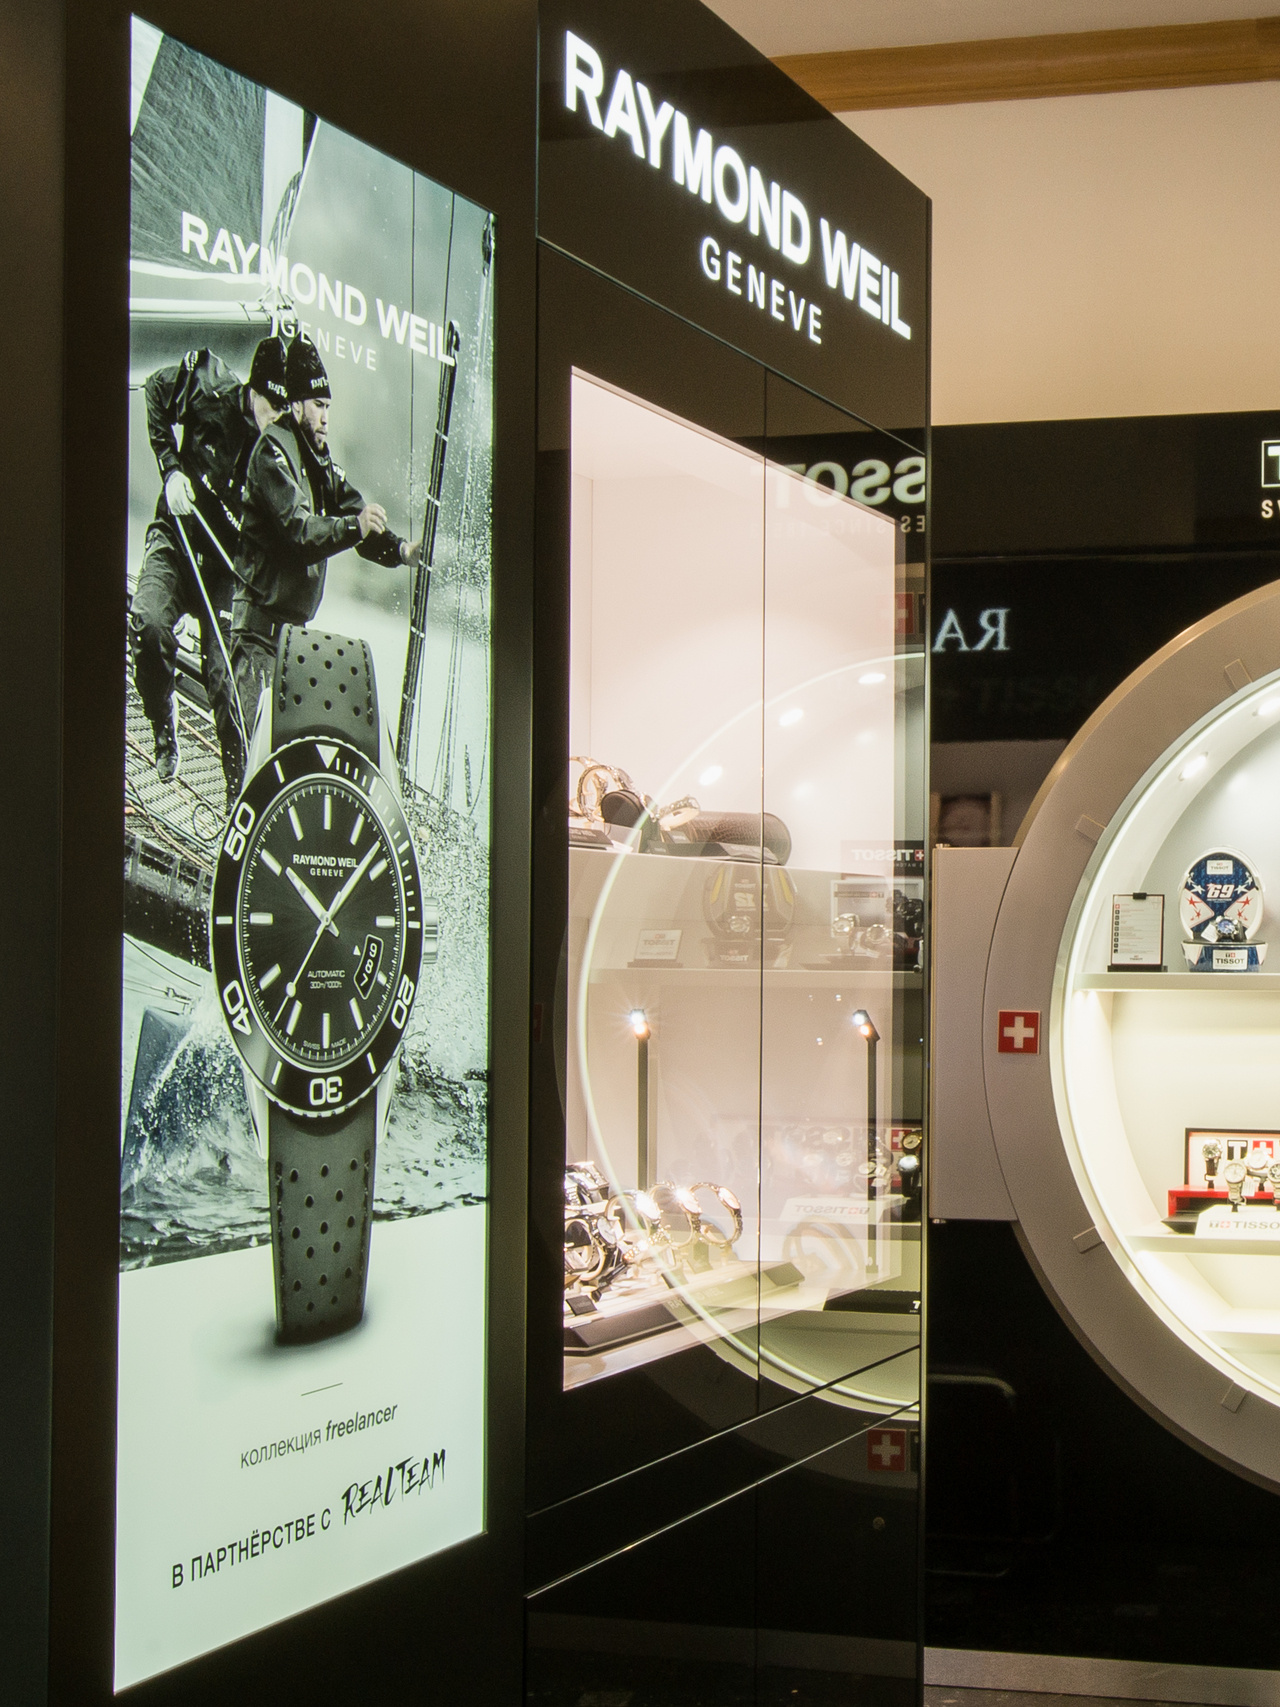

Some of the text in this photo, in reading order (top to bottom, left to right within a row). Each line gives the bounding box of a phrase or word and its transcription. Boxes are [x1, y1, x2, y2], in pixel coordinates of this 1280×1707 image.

[563, 30, 912, 340] RAYMOND WEIL
[181, 211, 457, 367] RAYMOND WEIL
[700, 237, 823, 345] GENEVE
[280, 317, 377, 372] GENEVE
[223, 802, 256, 862] 50
[292, 854, 360, 868] RAYMOND WEIL
[310, 867, 344, 877] GENEVE
[1207, 884, 1235, 898] 69
[307, 970, 346, 978] AUTOMATIC
[1215, 957, 1245, 965] TISSOT
[222, 980, 253, 1037] 40
[391, 973, 415, 1030] 20
[309, 1076, 343, 1106] 30
[240, 1403, 398, 1469] коллекция freelancer
[172, 1564, 184, 1589] В
[190, 1512, 316, 1582] ПАРТНЁРСТВЕ
